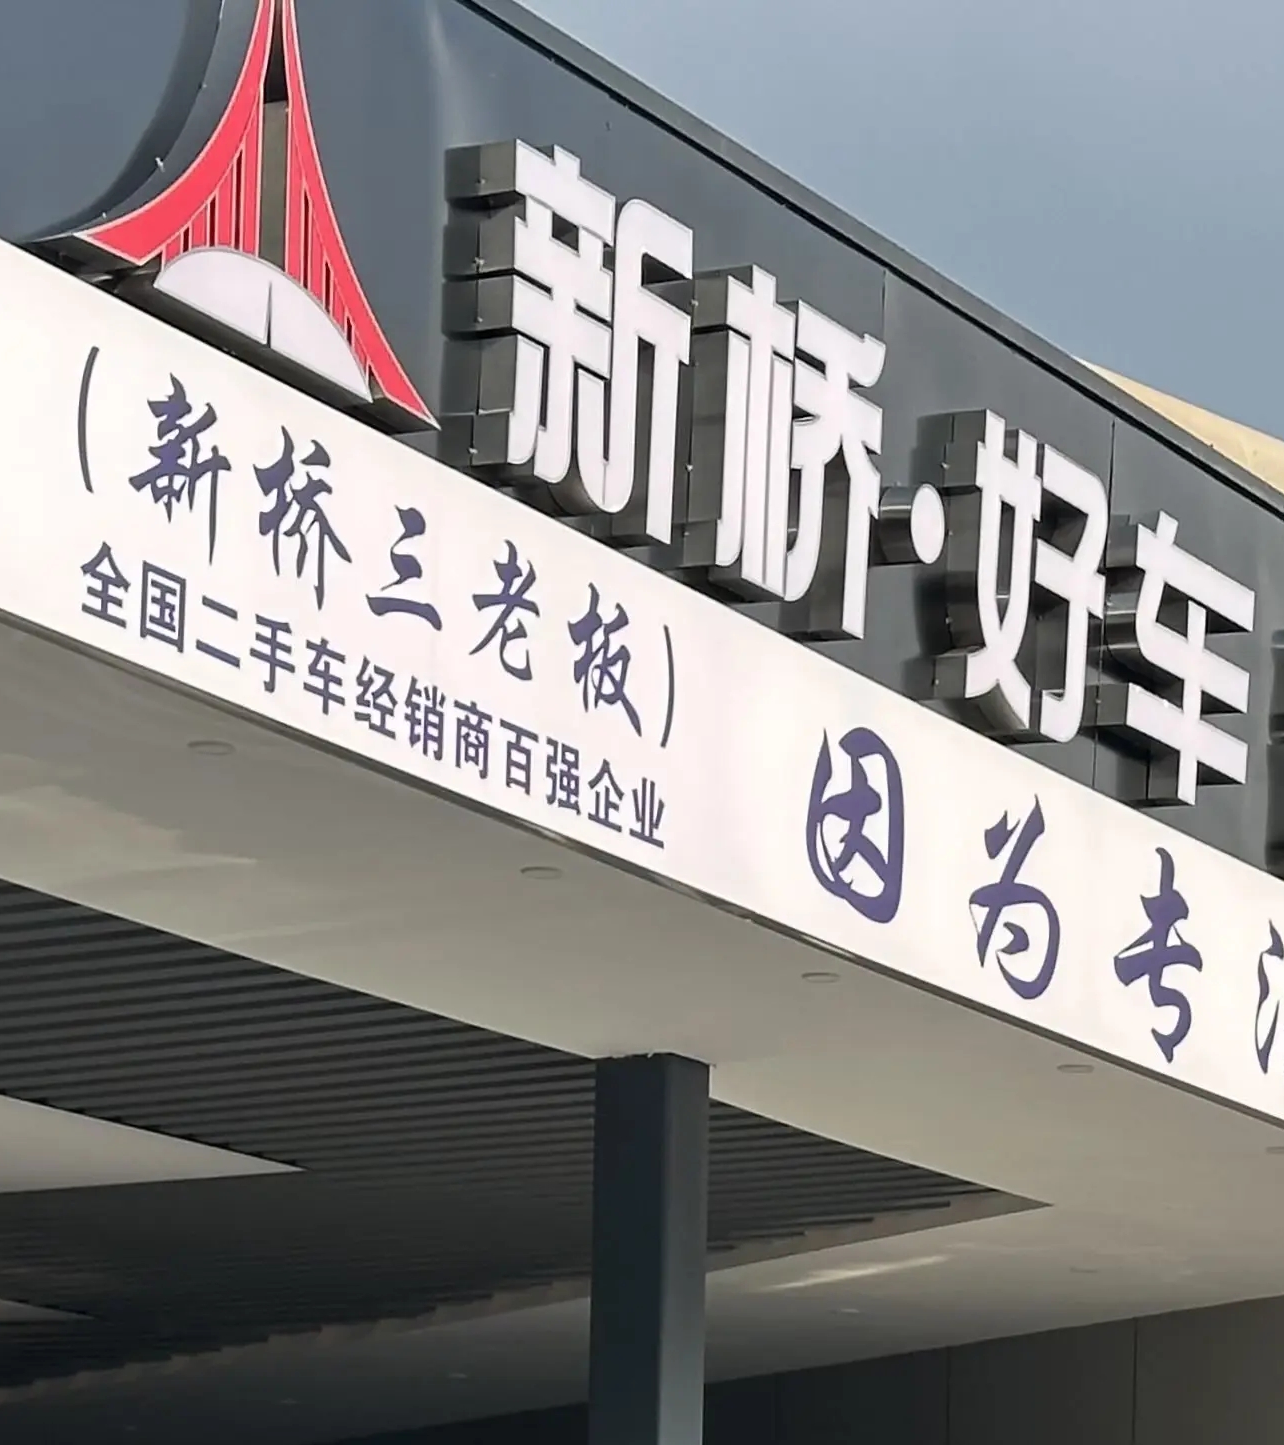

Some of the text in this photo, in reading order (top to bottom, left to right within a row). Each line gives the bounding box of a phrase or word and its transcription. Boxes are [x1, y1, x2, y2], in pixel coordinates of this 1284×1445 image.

[80, 541, 666, 851] 全国二手车经销商百强企业
[506, 136, 1256, 808] 新桥·好车
